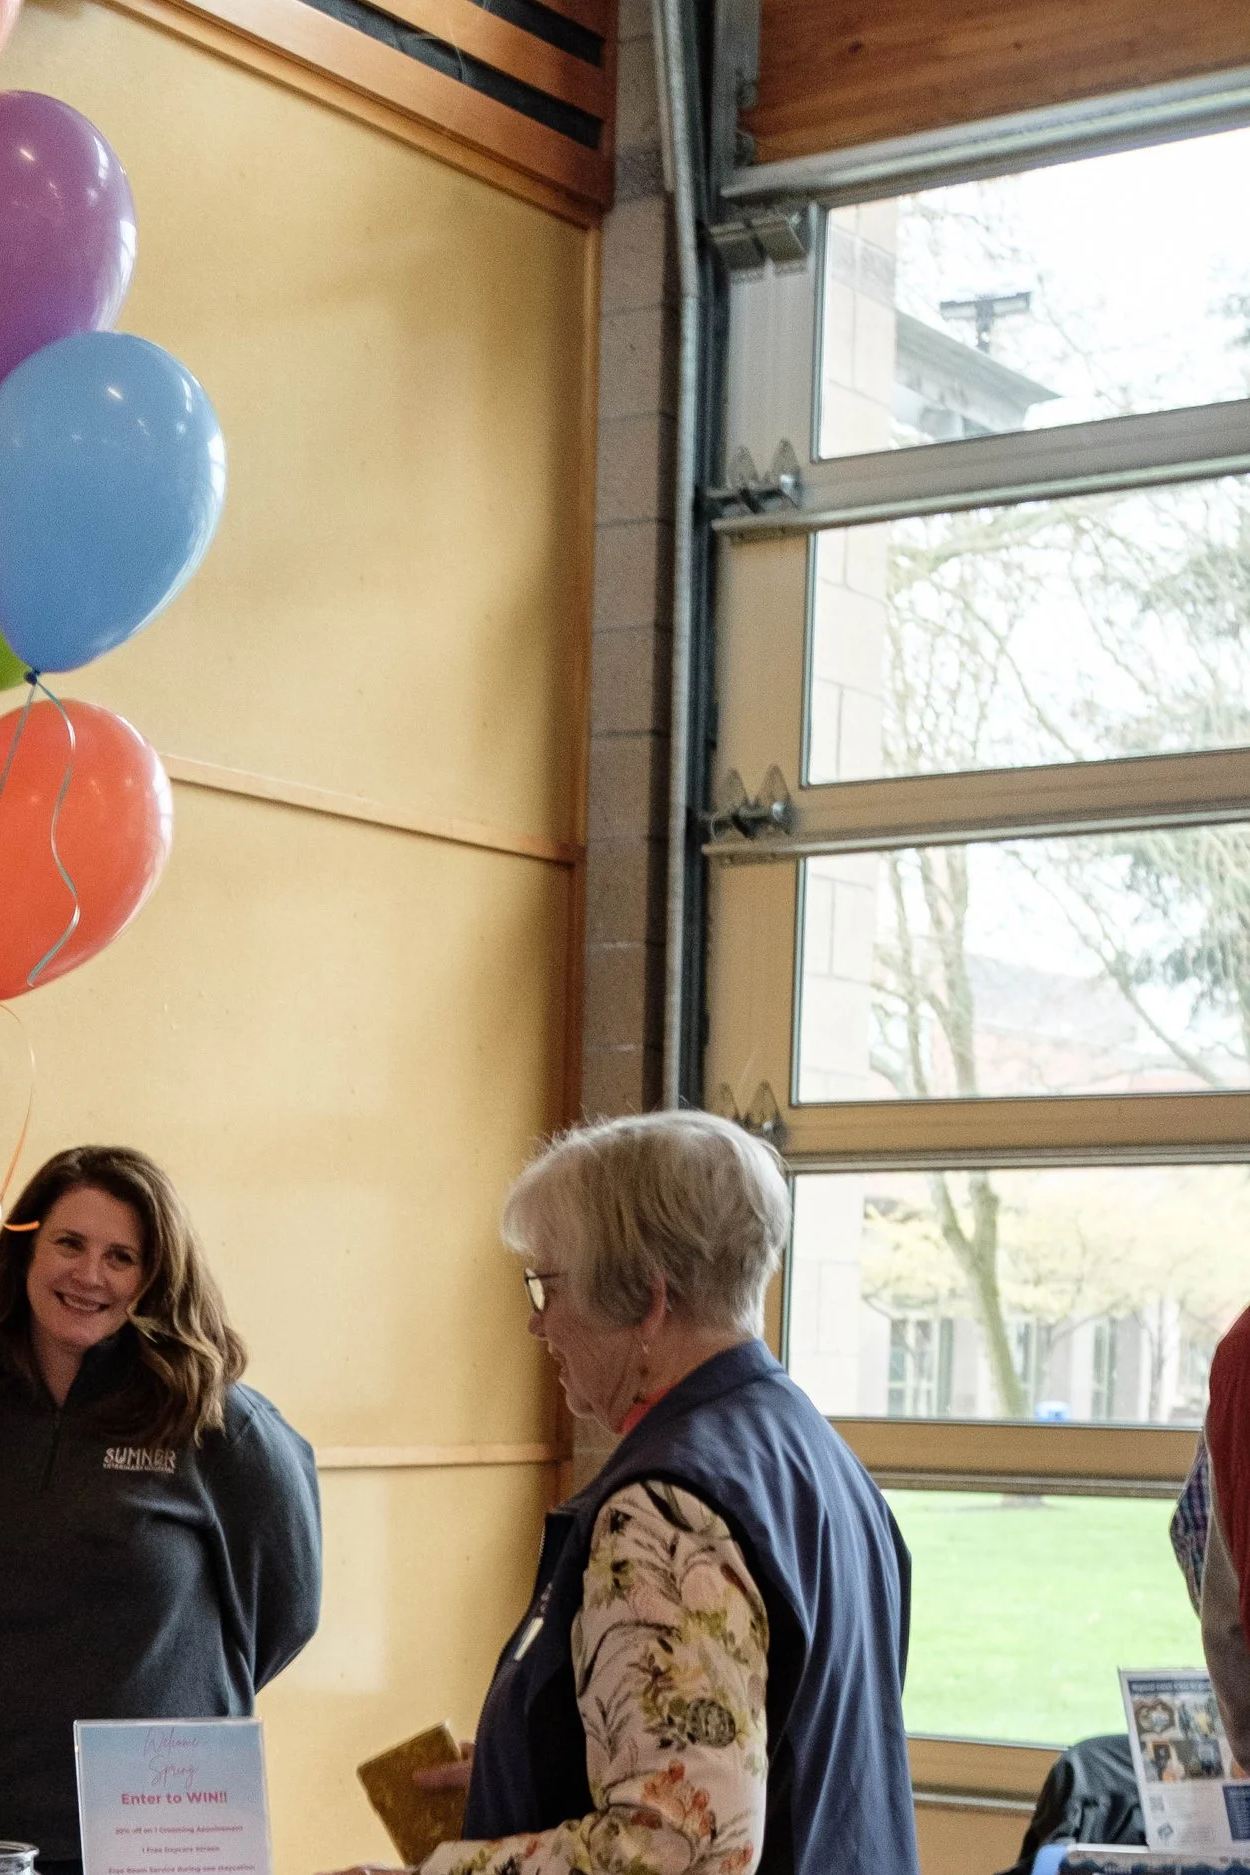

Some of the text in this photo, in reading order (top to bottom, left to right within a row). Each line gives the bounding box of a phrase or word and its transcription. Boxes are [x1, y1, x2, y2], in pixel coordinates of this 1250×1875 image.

[103, 1447, 177, 1469] SUMNER
[149, 1753, 199, 1790] Spring
[121, 1791, 227, 1805] Enter to WIN!!
